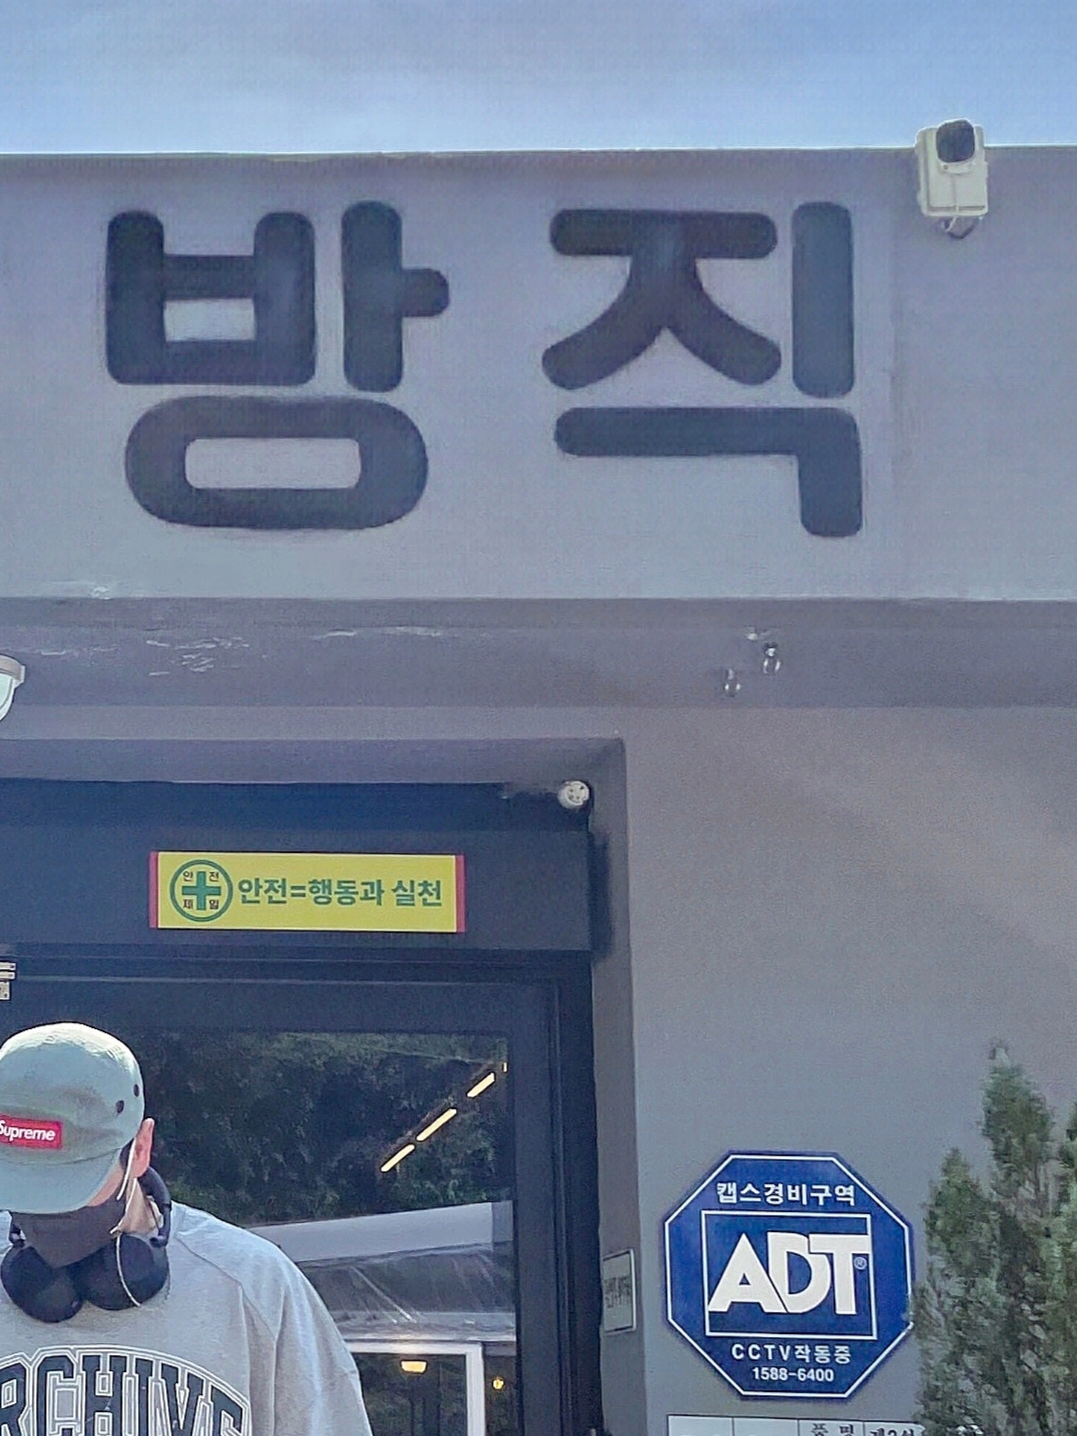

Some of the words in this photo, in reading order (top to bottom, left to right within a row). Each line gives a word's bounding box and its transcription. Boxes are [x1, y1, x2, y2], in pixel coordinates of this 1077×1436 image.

[238, 879, 383, 907] 안전=행동과
[390, 880, 443, 908] 실천
[717, 1183, 856, 1206] 캡스경비구역
[708, 1231, 871, 1315] ADT
[731, 1343, 851, 1363] CCTV작동중
[753, 1368, 835, 1382] 1588-6400
